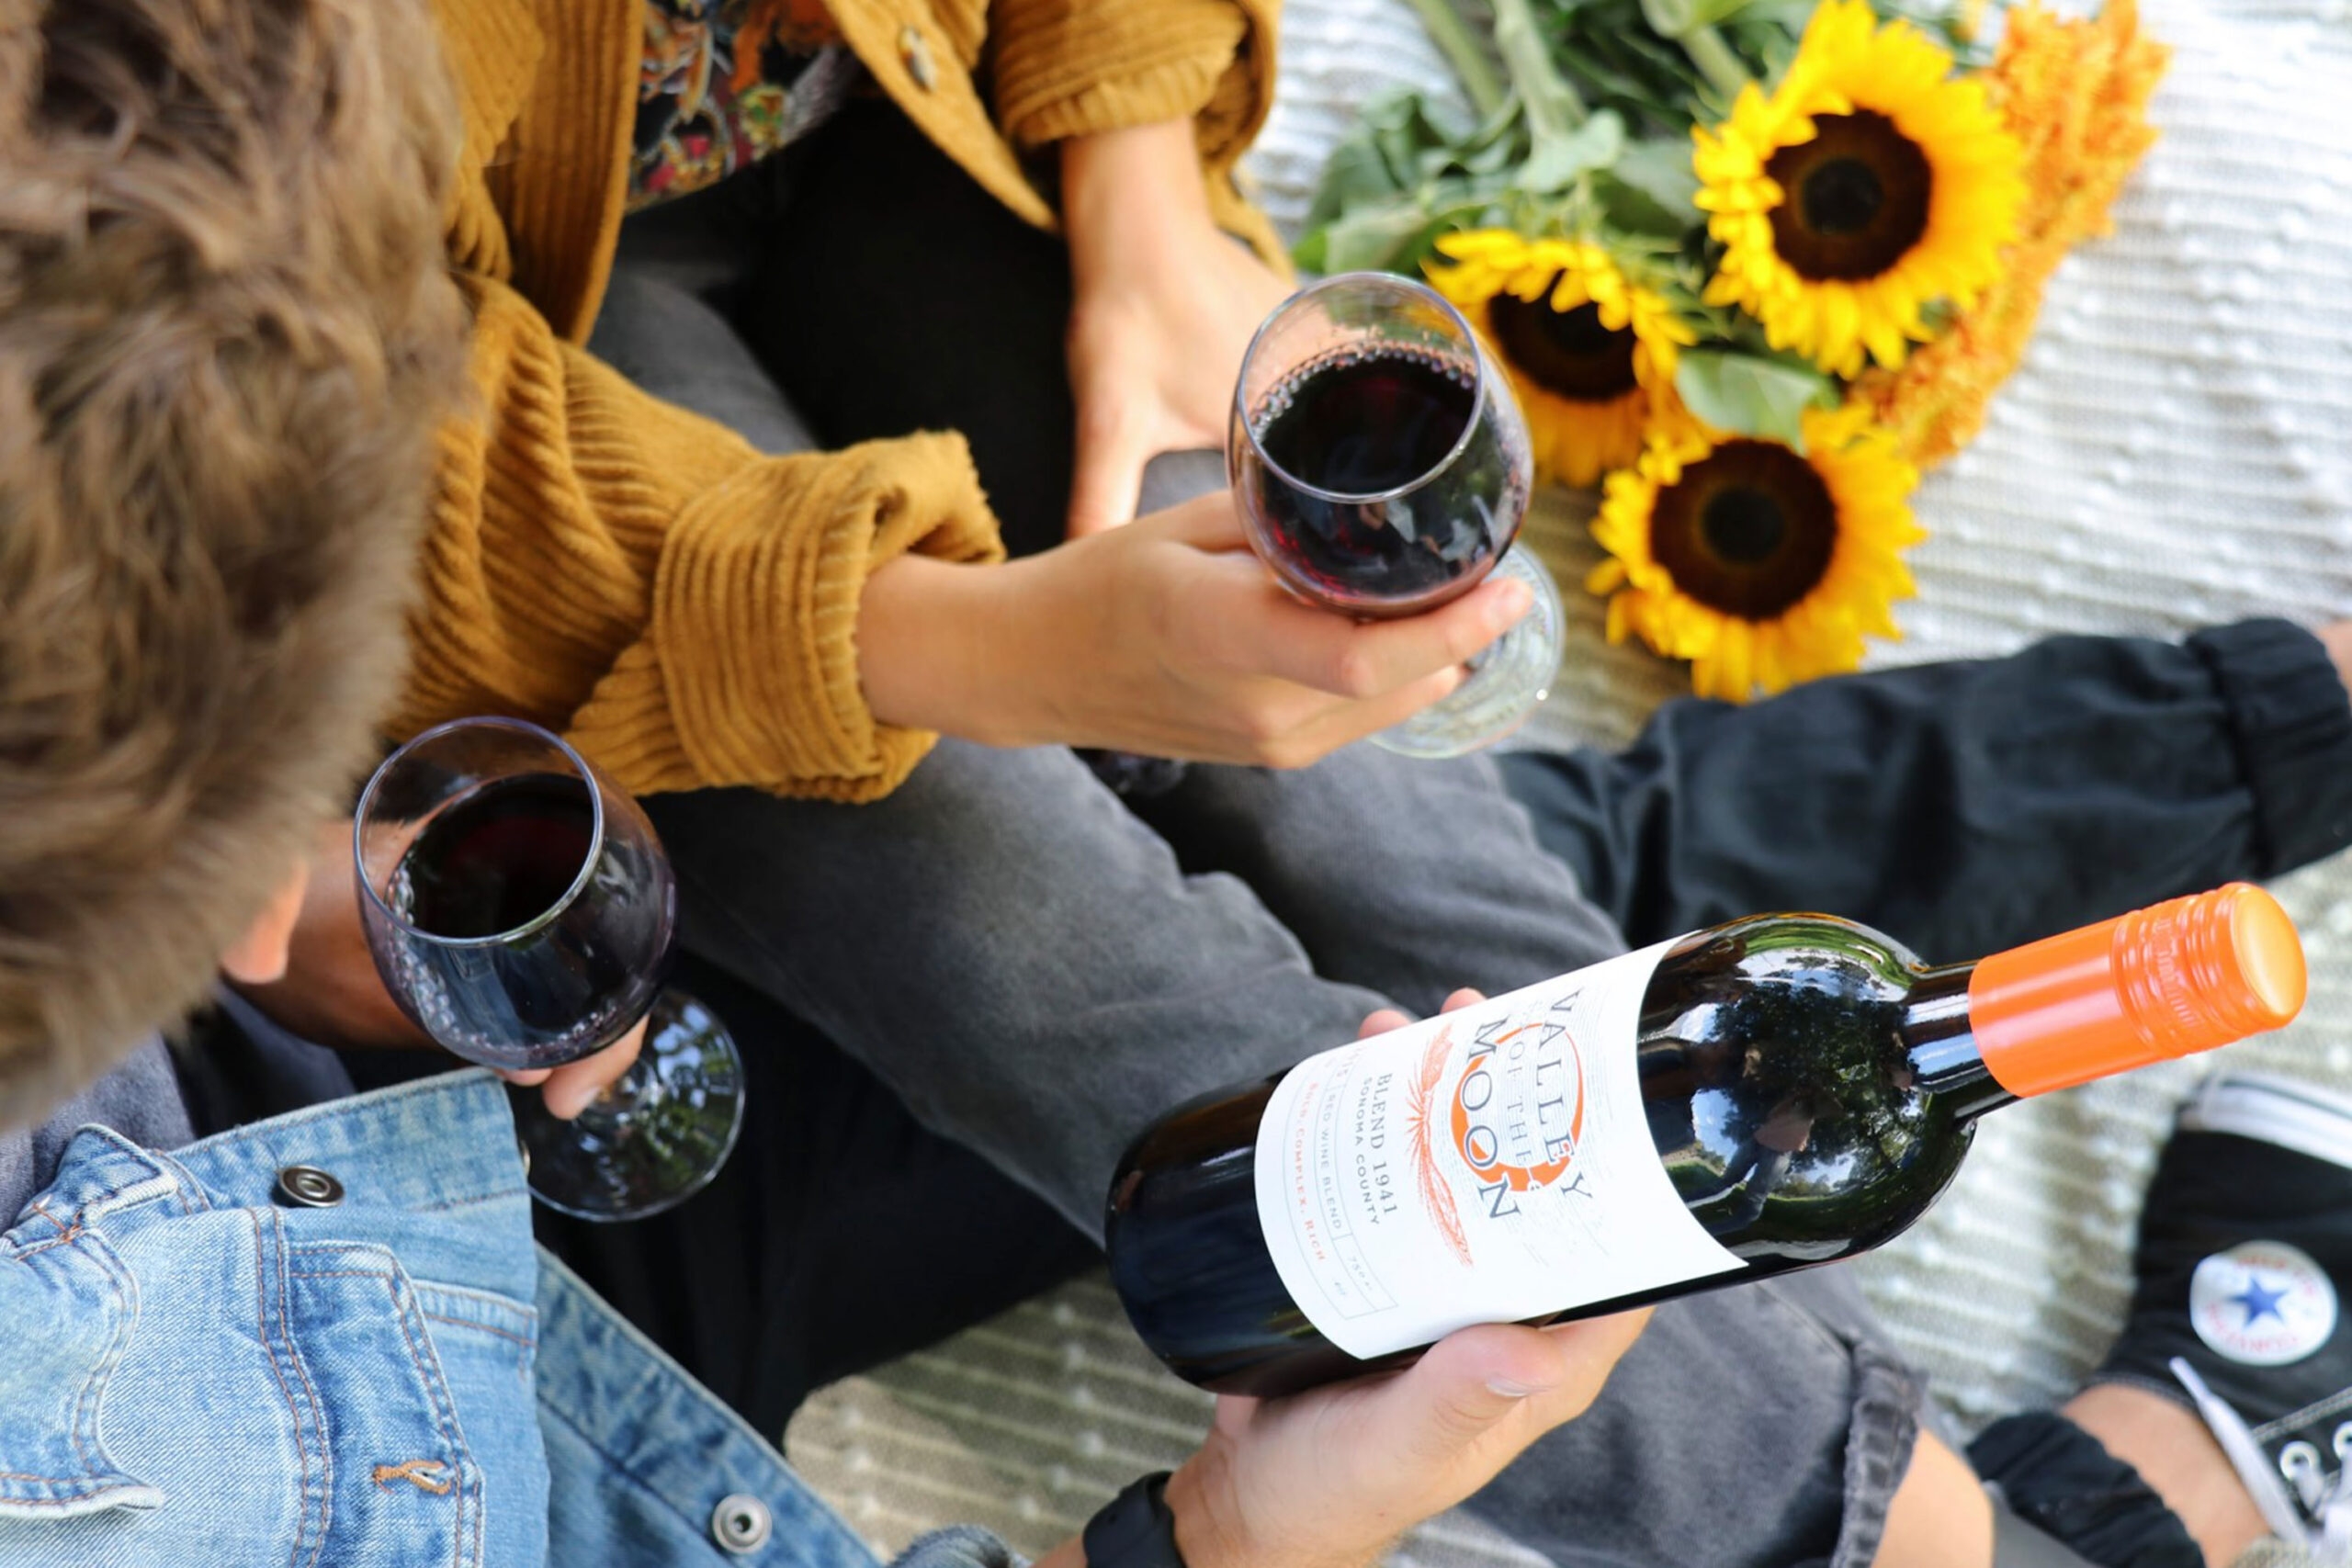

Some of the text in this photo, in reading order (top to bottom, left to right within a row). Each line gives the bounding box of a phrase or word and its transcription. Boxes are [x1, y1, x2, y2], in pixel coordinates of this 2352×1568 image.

[1320, 1093, 1341, 1229] RED WINE BLEND
[1355, 1077, 1380, 1224] SONOMA COUNTY
[1370, 1073, 1397, 1213] BLEND 1941
[1462, 1015, 1521, 1218] MOON
[1507, 1041, 1532, 1166] OF THE
[1537, 987, 1592, 1198] VALLEY
[1305, 1219, 1326, 1260] RICH
